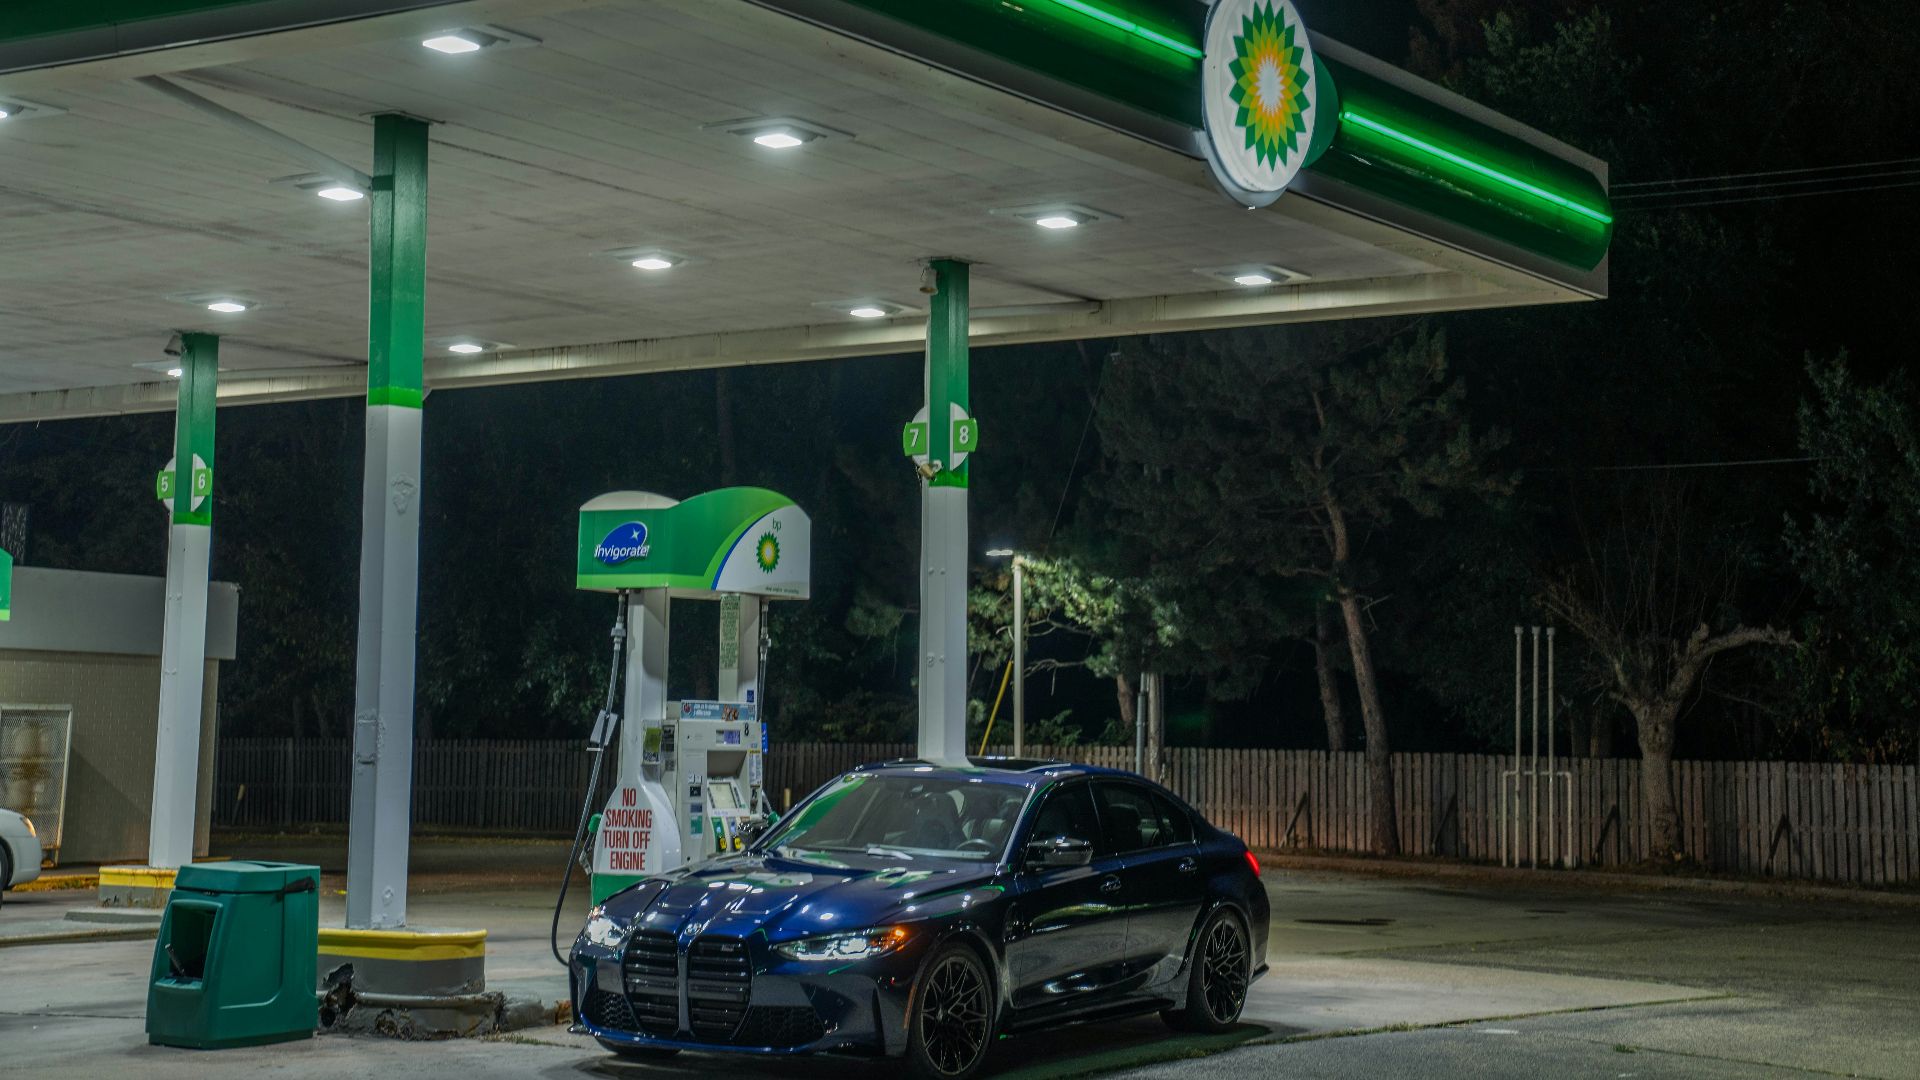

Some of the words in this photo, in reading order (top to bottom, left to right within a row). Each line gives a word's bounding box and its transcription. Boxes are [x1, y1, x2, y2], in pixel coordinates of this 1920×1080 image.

[909, 428, 920, 448] 7
[959, 425, 969, 444] 8
[161, 476, 169, 492] 5
[198, 473, 206, 489] 6
[773, 516, 782, 532] bp
[744, 722, 749, 736] 8
[622, 788, 637, 807] NO
[605, 809, 653, 829] SMOKING
[603, 830, 629, 849] TURN
[632, 831, 651, 849] OFF
[610, 851, 646, 871] ENGINE
